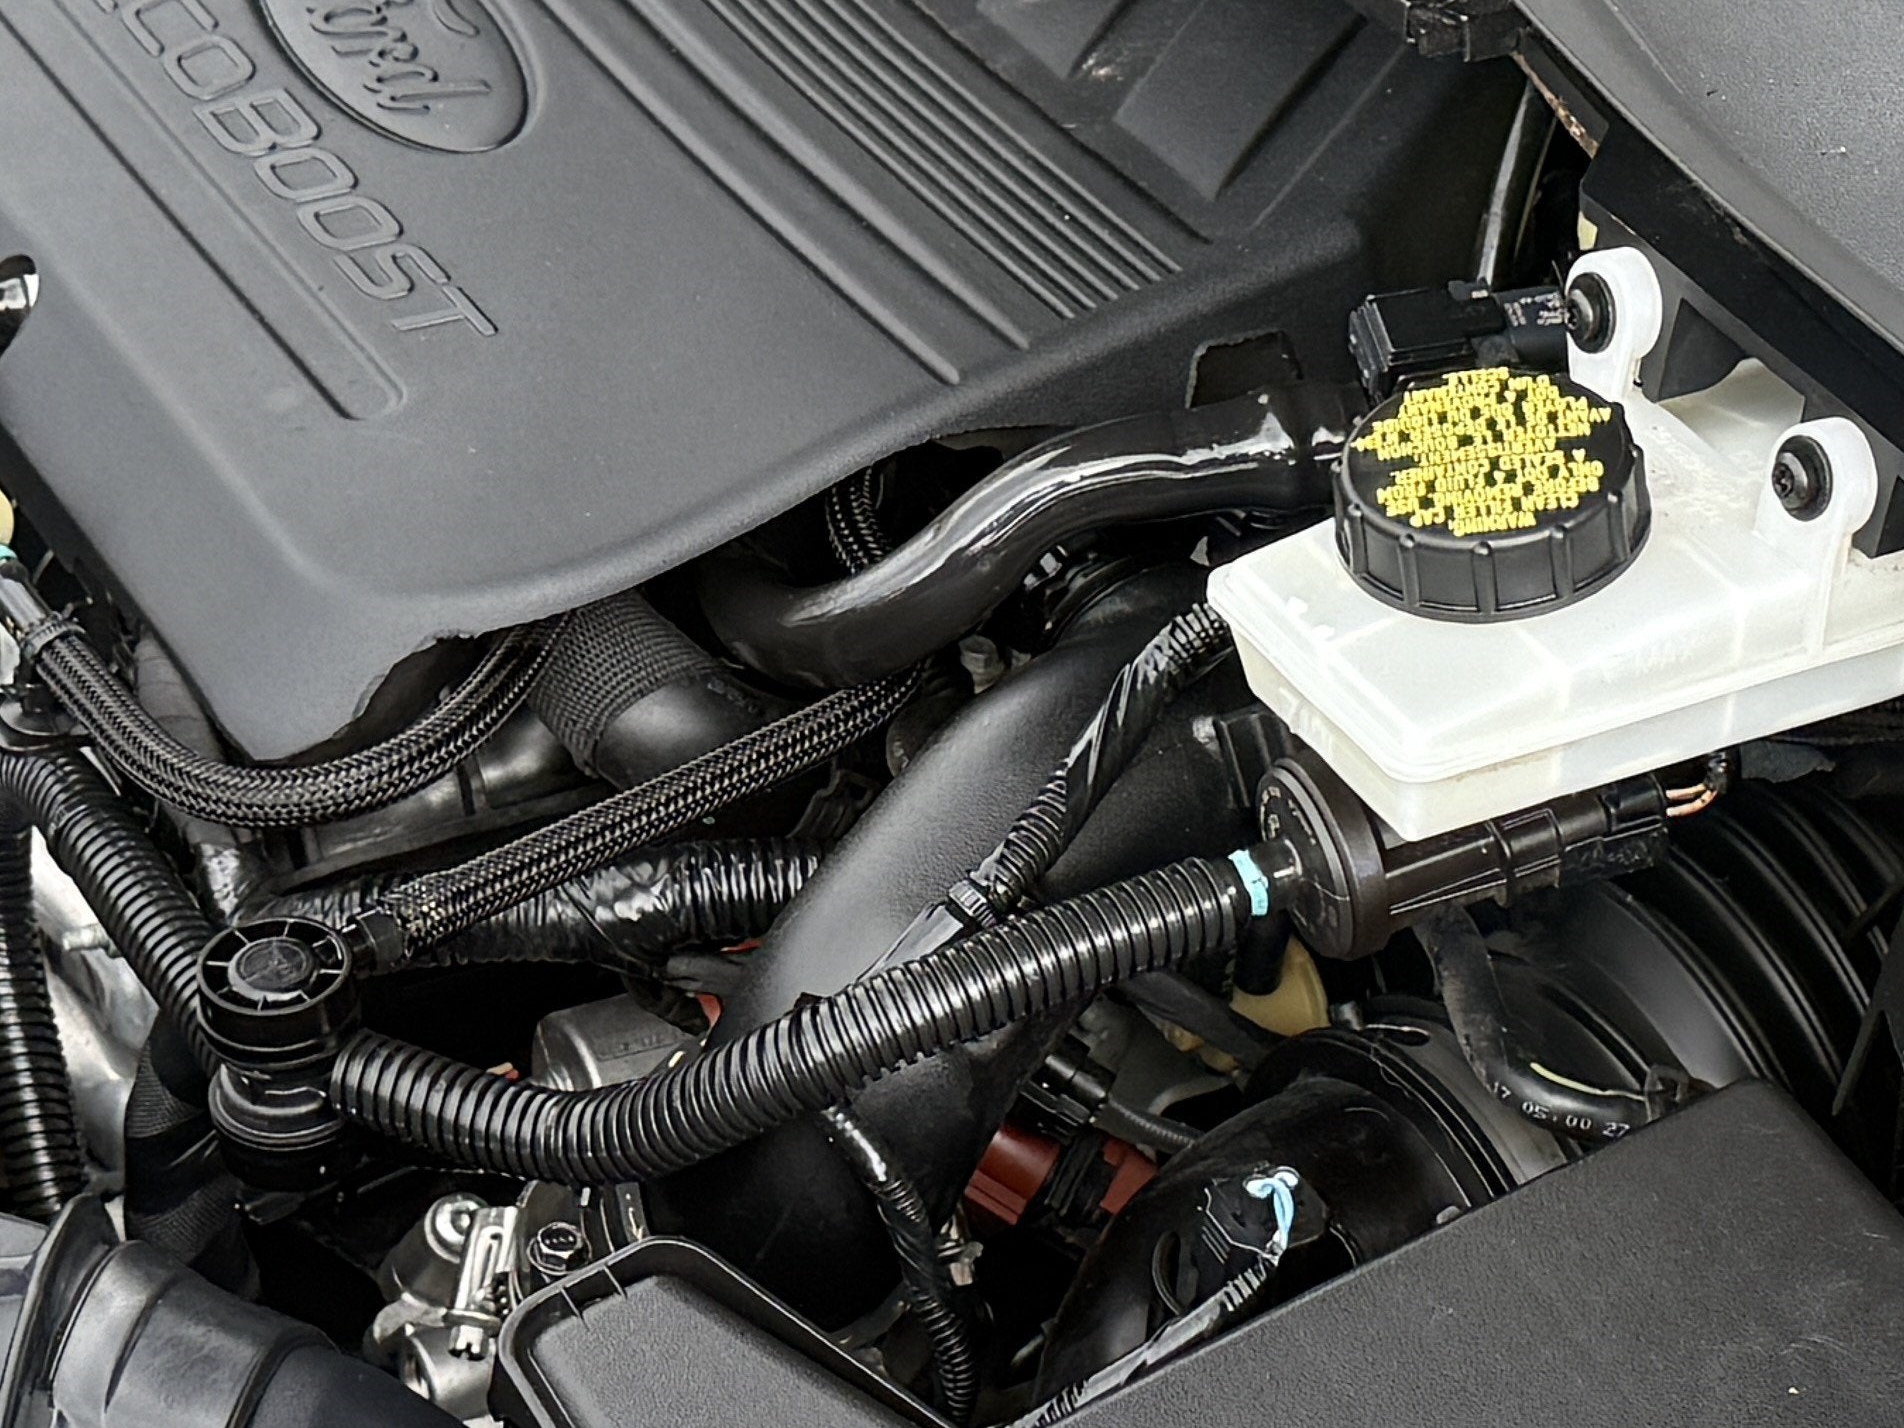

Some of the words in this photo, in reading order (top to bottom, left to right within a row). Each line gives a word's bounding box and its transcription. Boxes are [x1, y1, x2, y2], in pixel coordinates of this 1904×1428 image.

[1377, 436, 1457, 460] BOUCHON
[1516, 465, 1548, 482] DOT
[1558, 460, 1603, 478] ONLY
[1434, 472, 1485, 491] FLUID
[1532, 476, 1598, 494] BEFORE
[1376, 481, 1425, 503] FROM
[1386, 498, 1418, 515] USE
[1409, 508, 1445, 526] CAP
